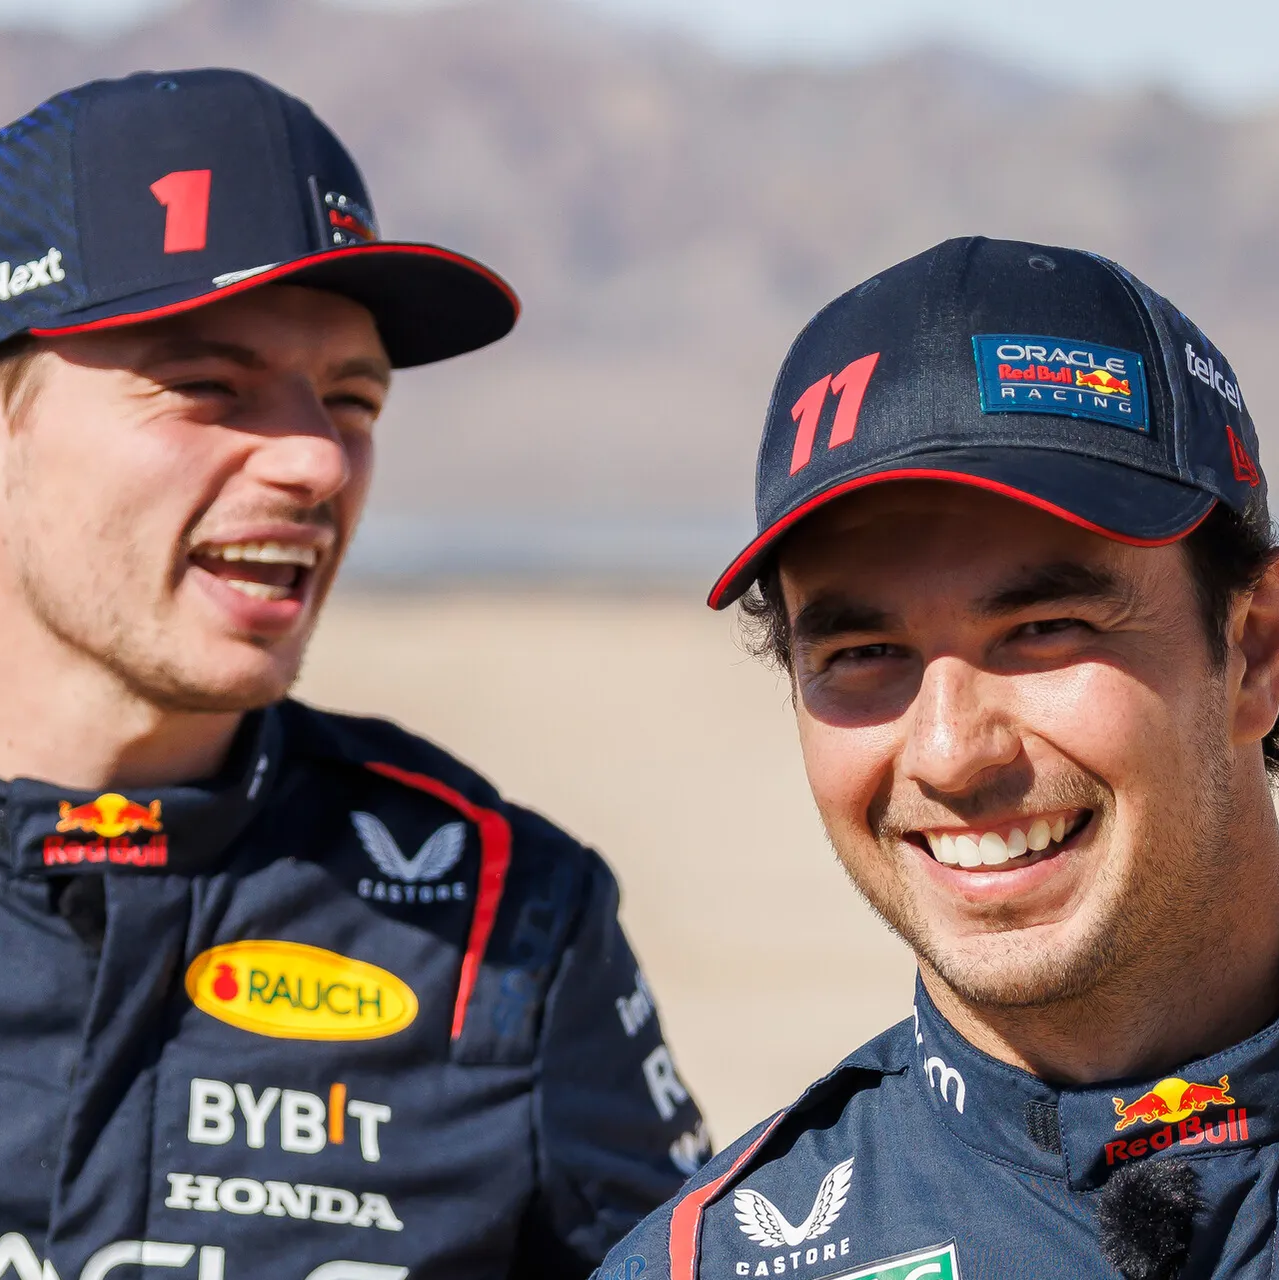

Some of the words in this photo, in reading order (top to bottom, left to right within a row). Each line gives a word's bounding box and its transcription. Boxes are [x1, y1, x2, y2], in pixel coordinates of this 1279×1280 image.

[150, 169, 212, 254] 1
[996, 344, 1126, 375] ORACLE
[998, 363, 1036, 381] Red
[1036, 365, 1072, 384] Bull
[1184, 343, 1243, 413] telcel
[790, 352, 880, 478] 11
[1001, 387, 1132, 413] RACING
[43, 835, 107, 866] Red
[109, 835, 169, 866] Bull
[358, 878, 468, 904] CASTORE
[249, 968, 384, 1020] RAUCH
[187, 1077, 392, 1163] BYBIT
[1104, 1121, 1177, 1166] Red
[1178, 1108, 1250, 1148] Bull
[165, 1171, 404, 1232] HONDA
[736, 1236, 851, 1277] CASTORE
